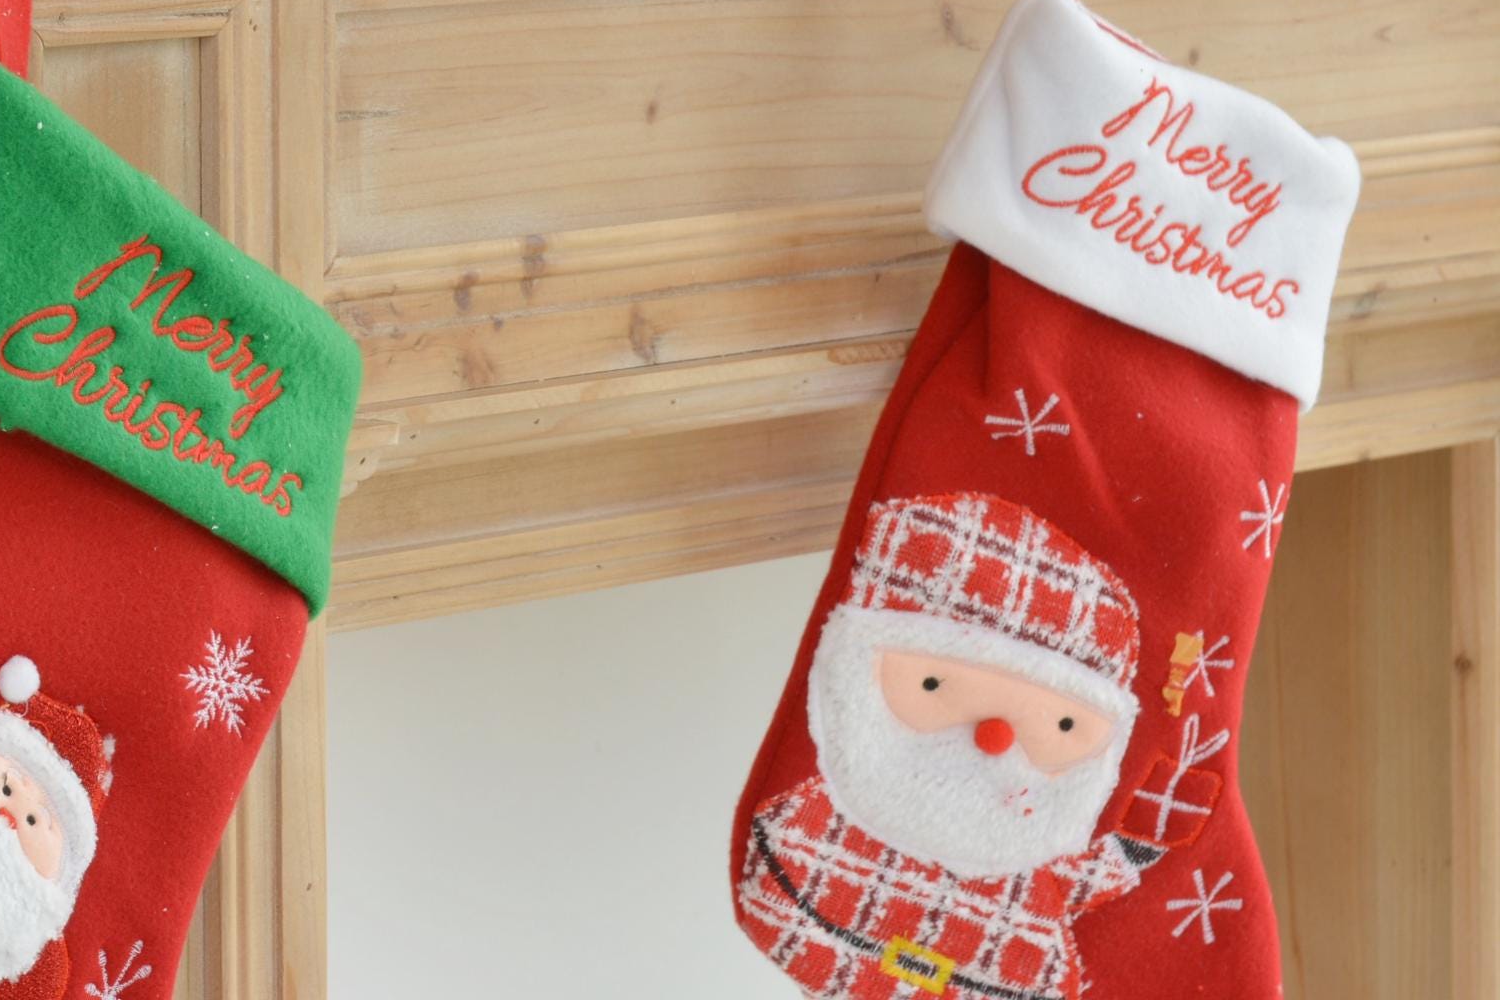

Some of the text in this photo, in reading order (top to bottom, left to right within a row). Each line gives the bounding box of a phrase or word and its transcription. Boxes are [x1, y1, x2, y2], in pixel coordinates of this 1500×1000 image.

[1021, 145, 1300, 319] Christmas
[1101, 77, 1282, 248] Merry
[74, 234, 284, 440] Merry
